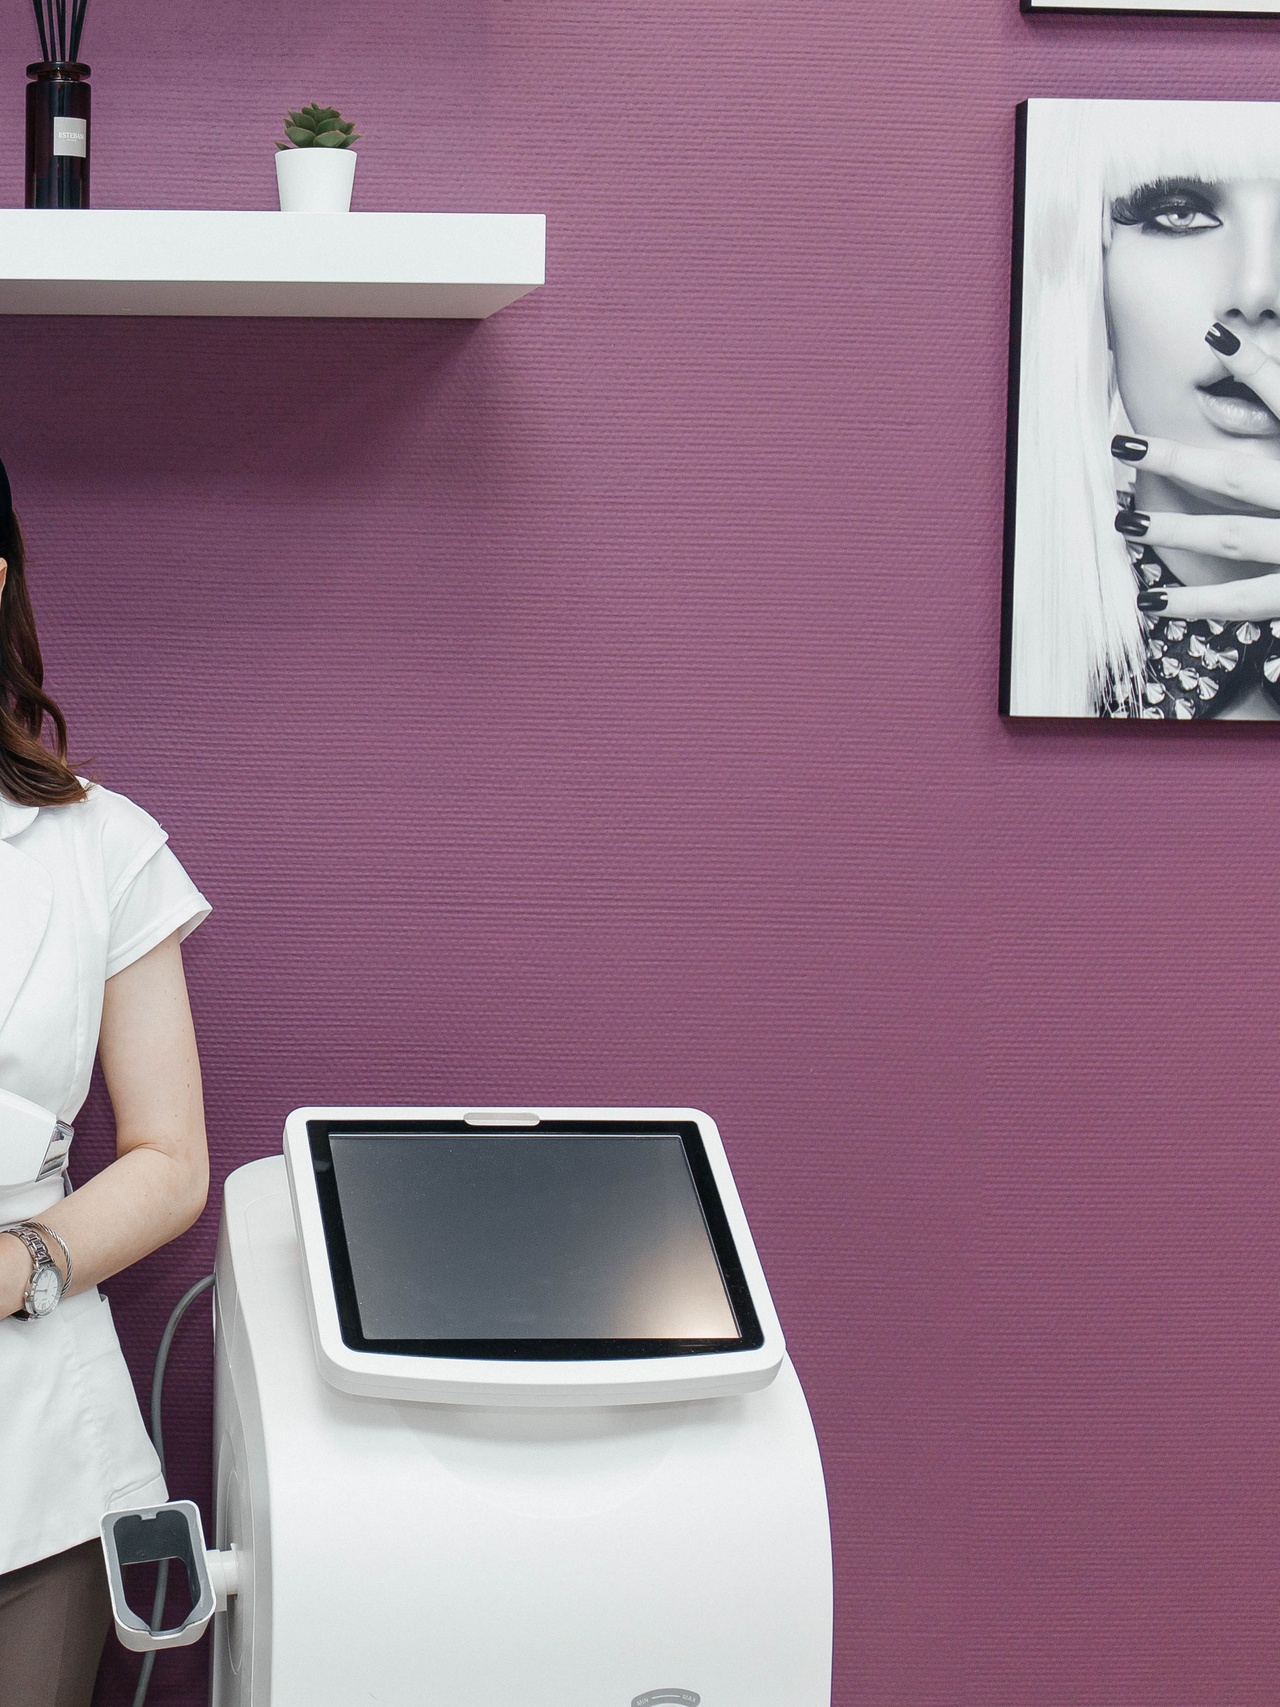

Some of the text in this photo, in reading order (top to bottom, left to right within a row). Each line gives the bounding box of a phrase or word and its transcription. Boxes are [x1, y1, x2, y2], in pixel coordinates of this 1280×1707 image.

[58, 131, 85, 140] ESTEBAN
[636, 1694, 697, 1707] MIN MAX
